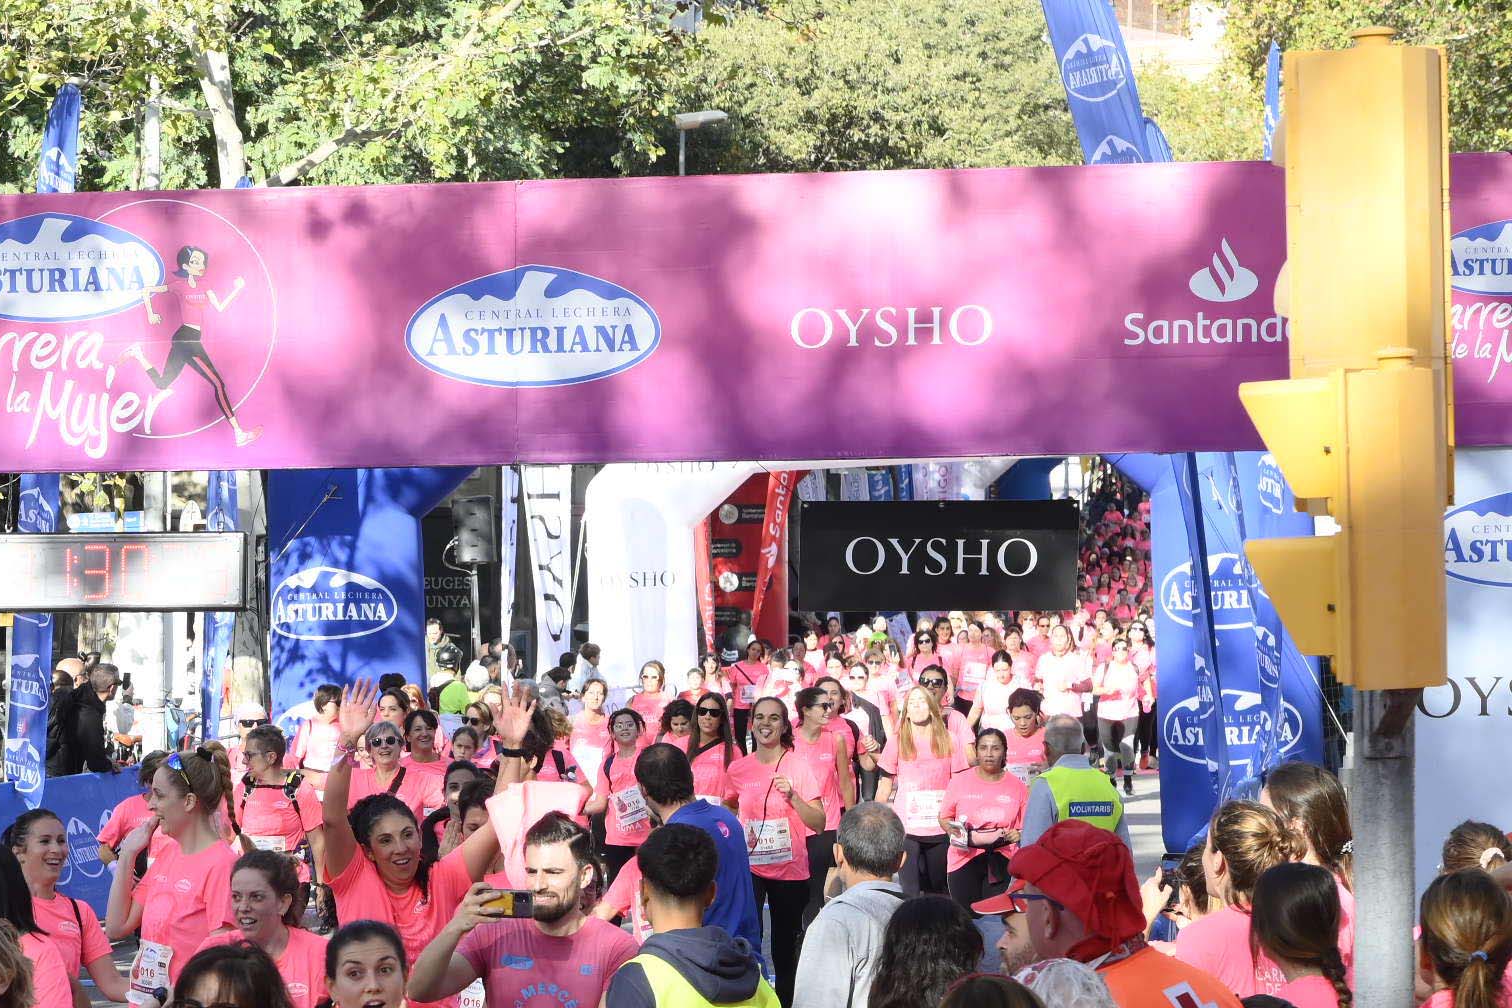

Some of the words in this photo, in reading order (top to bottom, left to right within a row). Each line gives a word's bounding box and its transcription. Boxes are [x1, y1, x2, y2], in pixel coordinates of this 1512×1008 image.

[465, 308, 544, 320] CENTRAL
[552, 306, 632, 319] LECHERA
[790, 304, 994, 351] OYSHO
[1124, 312, 1290, 346] Santand
[1451, 301, 1512, 331] arre
[425, 312, 641, 357] ASTURIANA
[6, 374, 32, 413] la
[26, 362, 175, 459] Mujer
[844, 535, 1039, 578] OYSHO
[275, 597, 389, 623] ASTURIANA
[287, 591, 330, 601] CENTRAL
[334, 591, 384, 601] LECHERA
[1416, 676, 1512, 719] OY
[1070, 805, 1112, 814] VOLUNTARIS
[140, 966, 155, 978] 016
